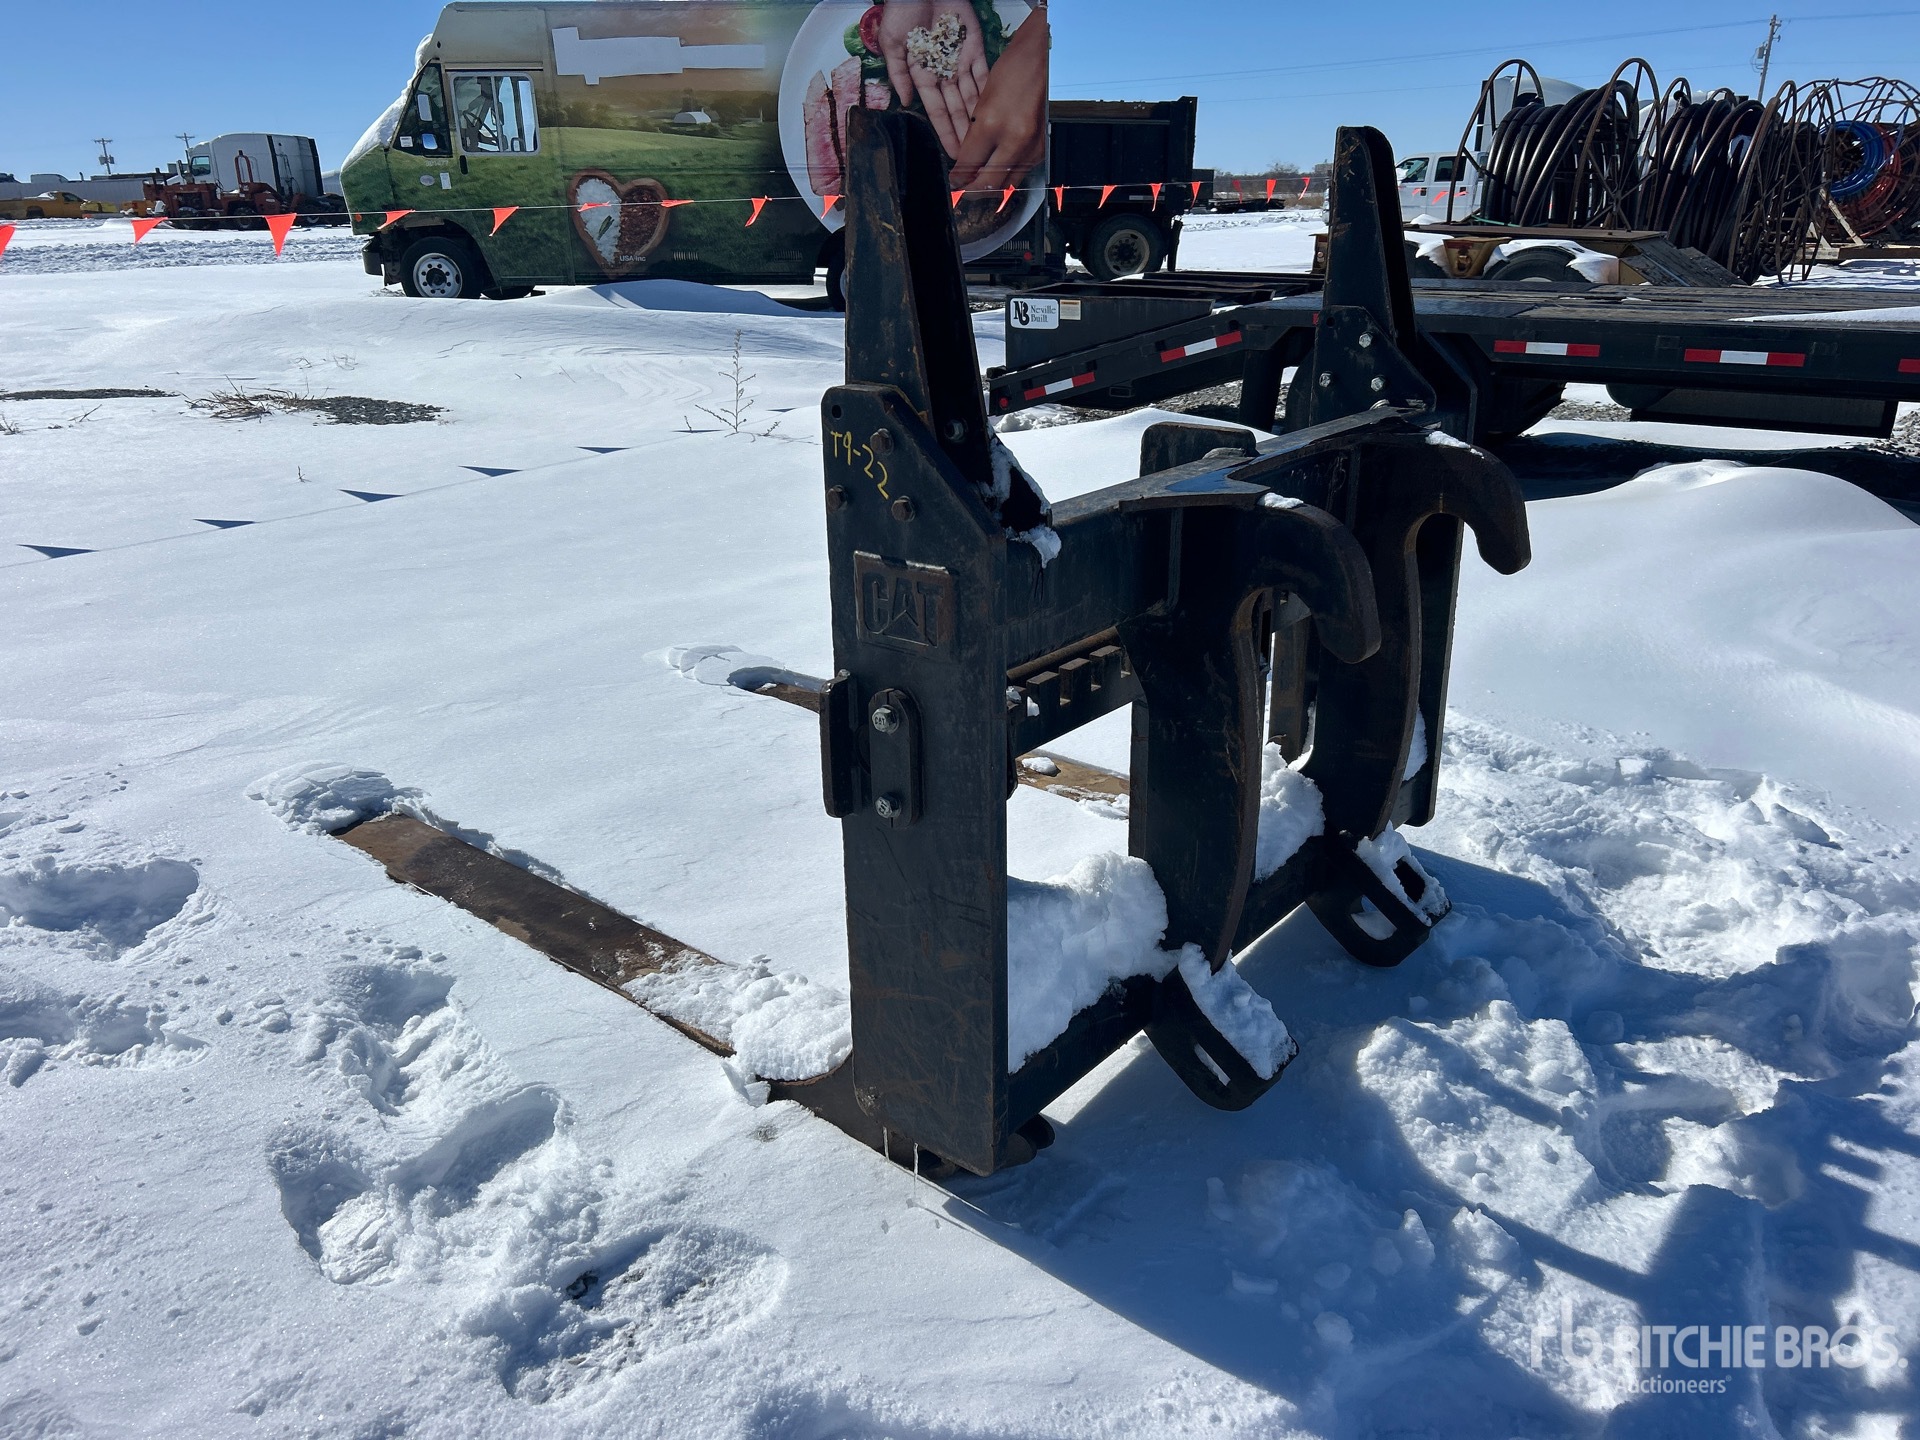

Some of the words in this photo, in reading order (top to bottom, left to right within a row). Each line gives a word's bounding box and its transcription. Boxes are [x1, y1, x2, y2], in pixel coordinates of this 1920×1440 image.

[1031, 305, 1057, 314] Neville
[1031, 314, 1048, 322] Built
[830, 430, 889, 500] T9-22
[862, 572, 944, 648] CAT
